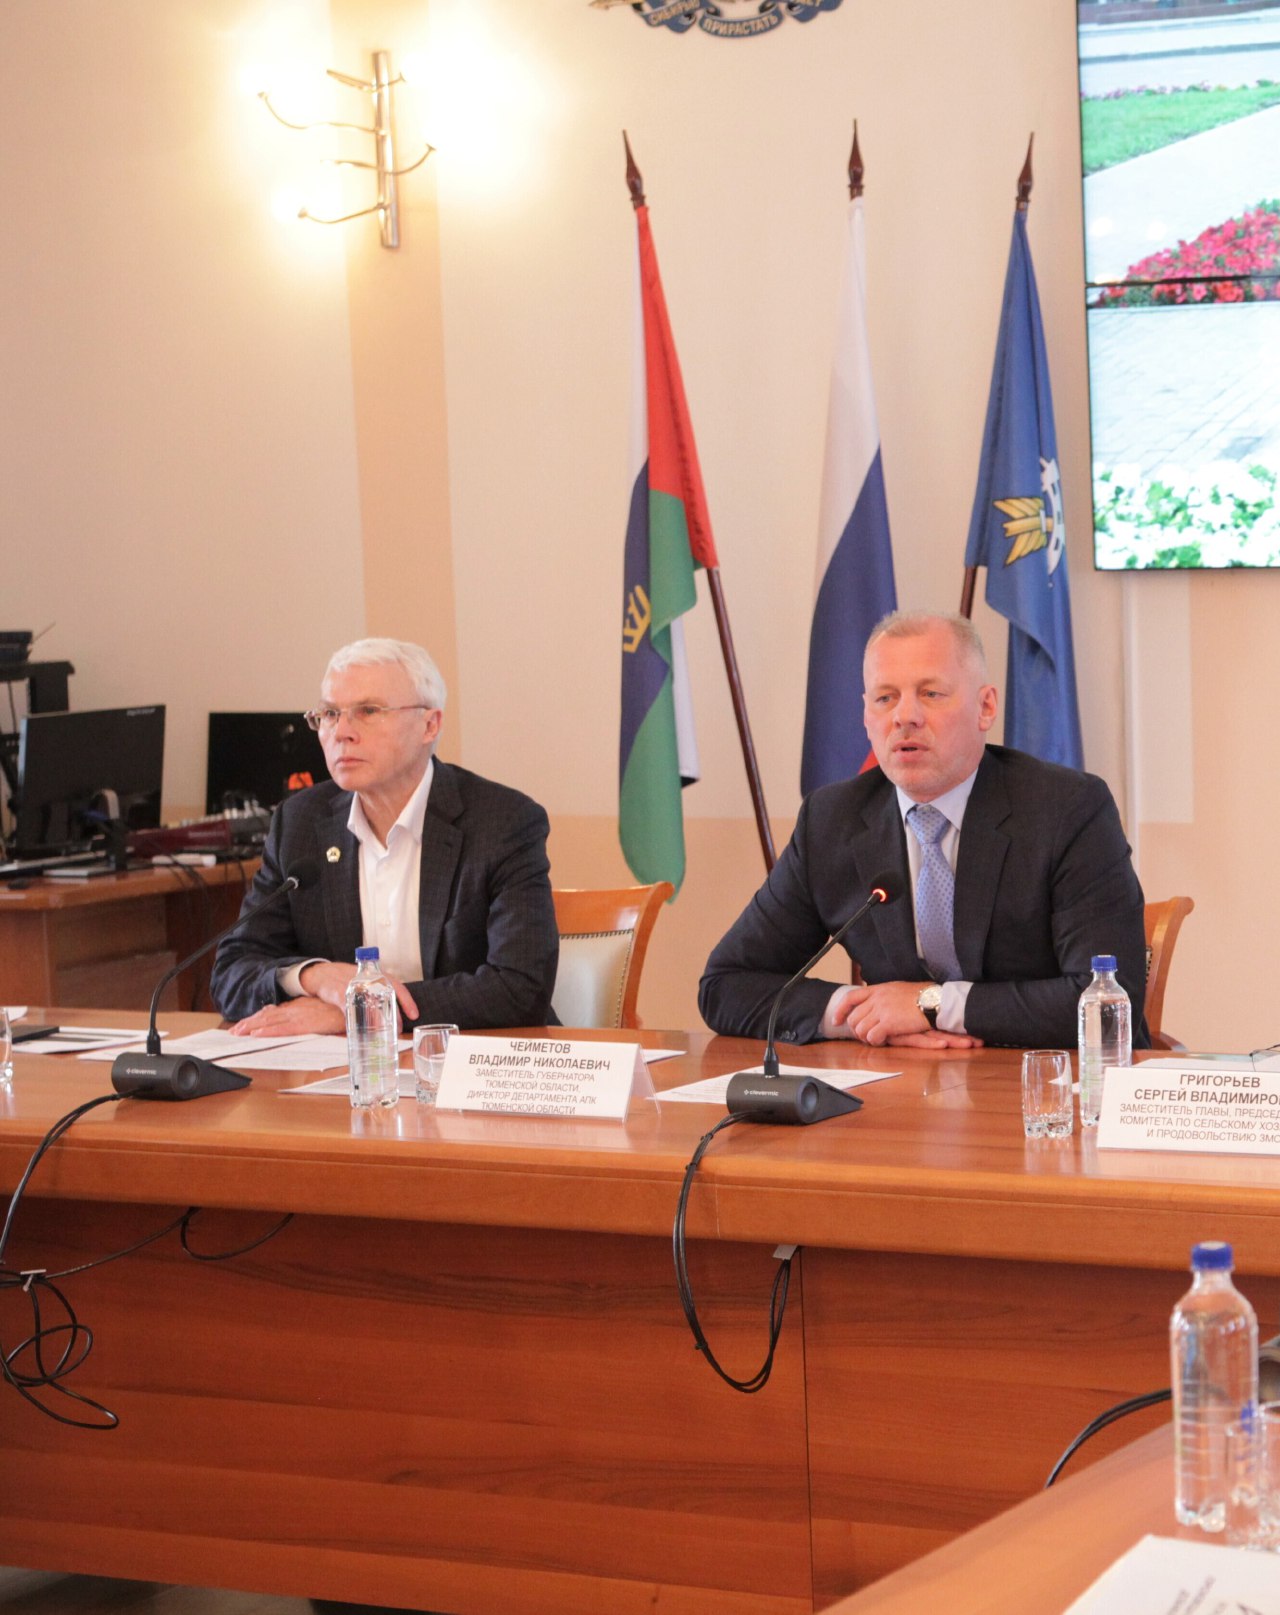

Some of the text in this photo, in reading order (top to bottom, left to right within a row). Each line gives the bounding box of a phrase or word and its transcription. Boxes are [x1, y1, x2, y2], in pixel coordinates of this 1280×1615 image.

[703, 13, 780, 36] ПРИРАСТАТЬ
[510, 1040, 571, 1054] ЧЕЙМЕТОВ
[469, 1054, 611, 1071] ВЛАДИМИР НИКОЛАЕВИЧ
[475, 1068, 595, 1082] ЗАМЕСТИТЕЛЬ ГУБЕРНАТОРА
[1180, 1074, 1261, 1088] ГРИГОРЬЕВ
[485, 1079, 538, 1090] ТЮМЕНСКОЙ
[467, 1090, 597, 1105] ДИРЕКТОР ДЕПАРТАМЕНТА АПК
[1134, 1087, 1187, 1102] СЕРГЕЙ
[482, 1101, 576, 1115] ТЮМЕНСКОЙ ОБЛАСТИ
[1120, 1103, 1193, 1116] ЗАМЕСТИТЕЛЬ
[1195, 1106, 1232, 1118] ГЛАВЫ,
[1120, 1116, 1173, 1128] КОМИТЕТА
[1175, 1118, 1191, 1128] ПО
[1193, 1119, 1257, 1131] СЕЛЬСКОМУ
[1146, 1128, 1155, 1138] И
[1157, 1129, 1257, 1143] ПРОДОВОЛЬСТВИЮ
